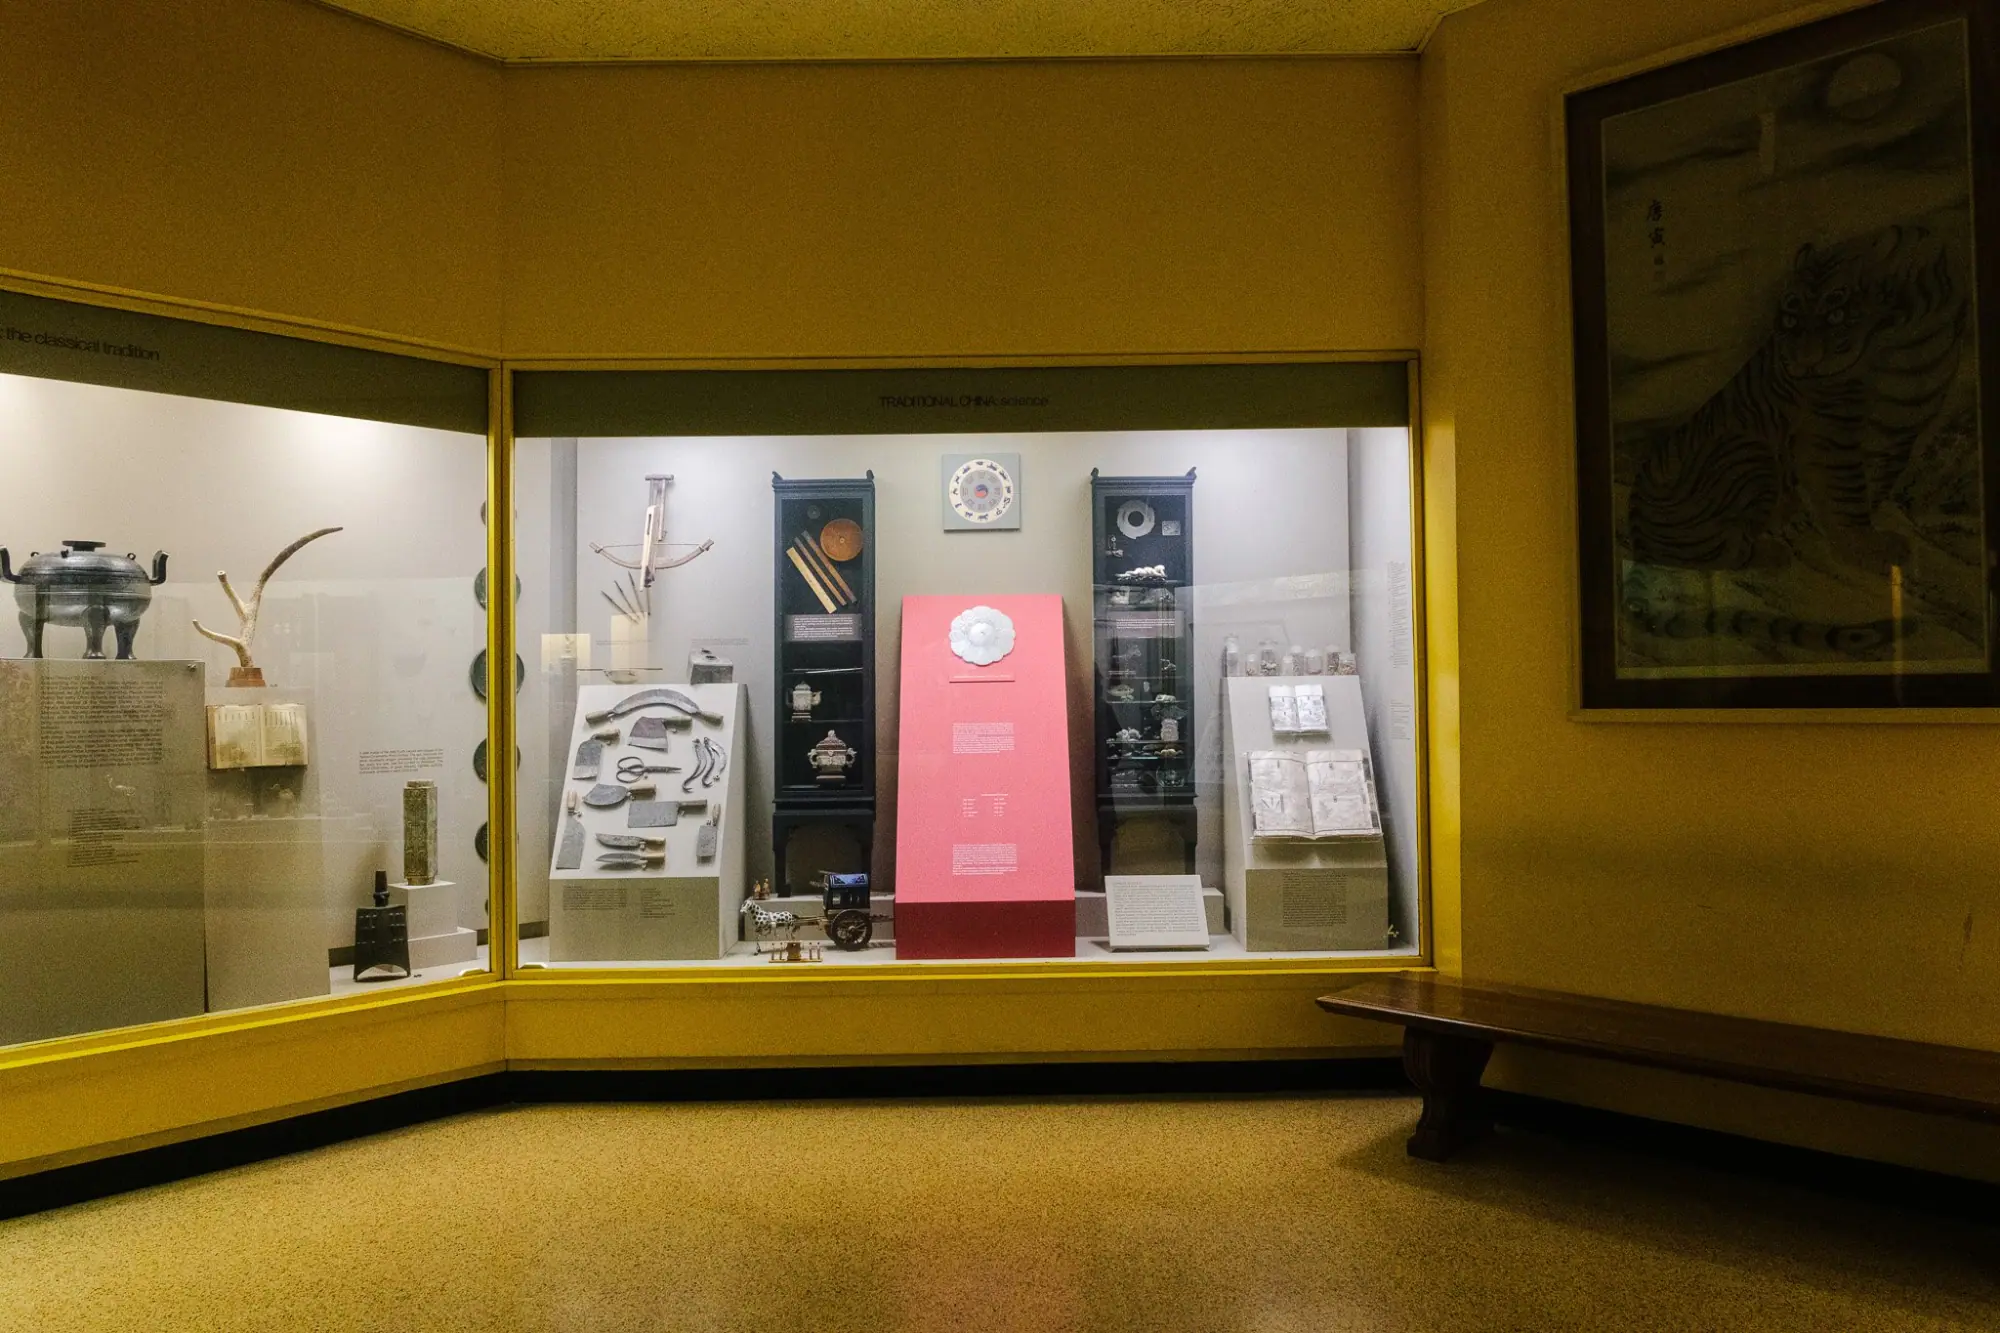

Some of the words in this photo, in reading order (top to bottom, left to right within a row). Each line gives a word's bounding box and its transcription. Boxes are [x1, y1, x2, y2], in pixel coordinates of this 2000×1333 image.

[6, 326, 33, 344] the
[34, 331, 100, 354] classical
[103, 341, 160, 361] tradition
[878, 395, 957, 408] TRADITIONAL
[1000, 395, 1049, 407] science
